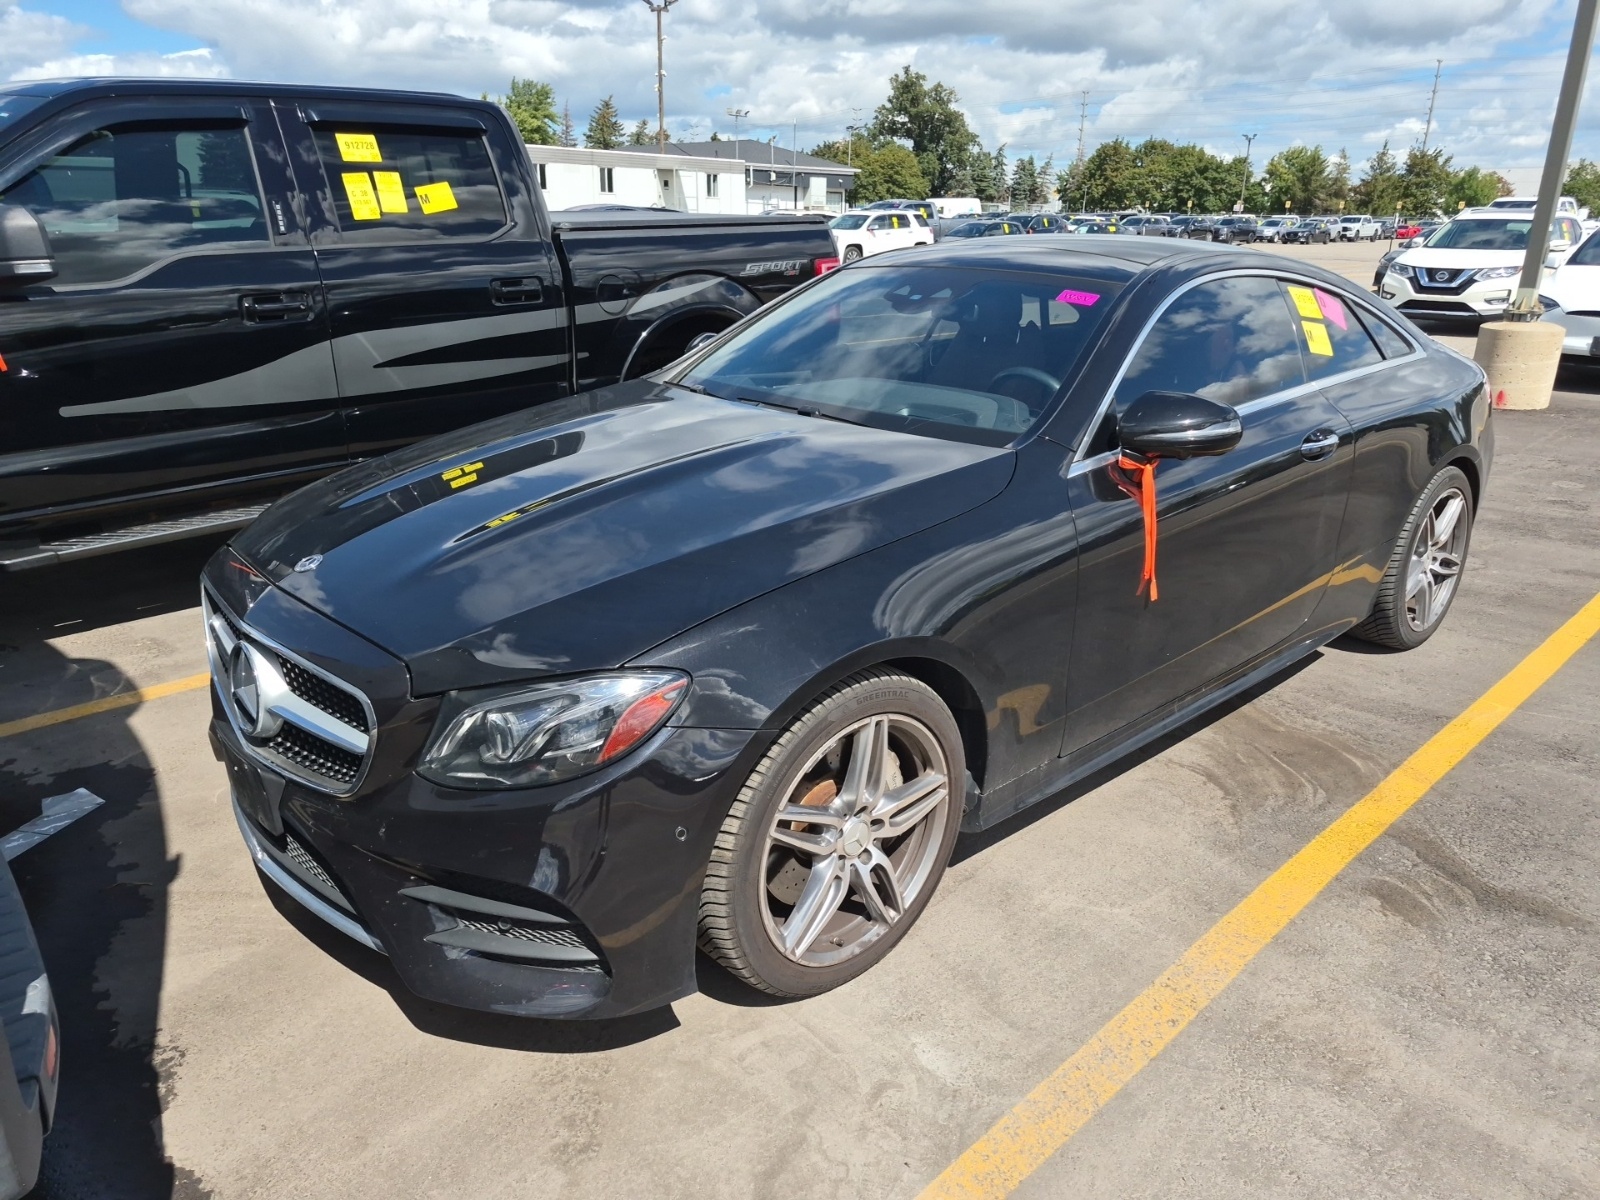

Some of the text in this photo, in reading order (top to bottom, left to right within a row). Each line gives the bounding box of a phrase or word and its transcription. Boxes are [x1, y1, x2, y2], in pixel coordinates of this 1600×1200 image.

[344, 141, 375, 150] 912728
[419, 193, 431, 205] M
[739, 260, 808, 276] SPORT
[1306, 329, 1314, 342] M
[856, 691, 910, 705] GREENTRAC
